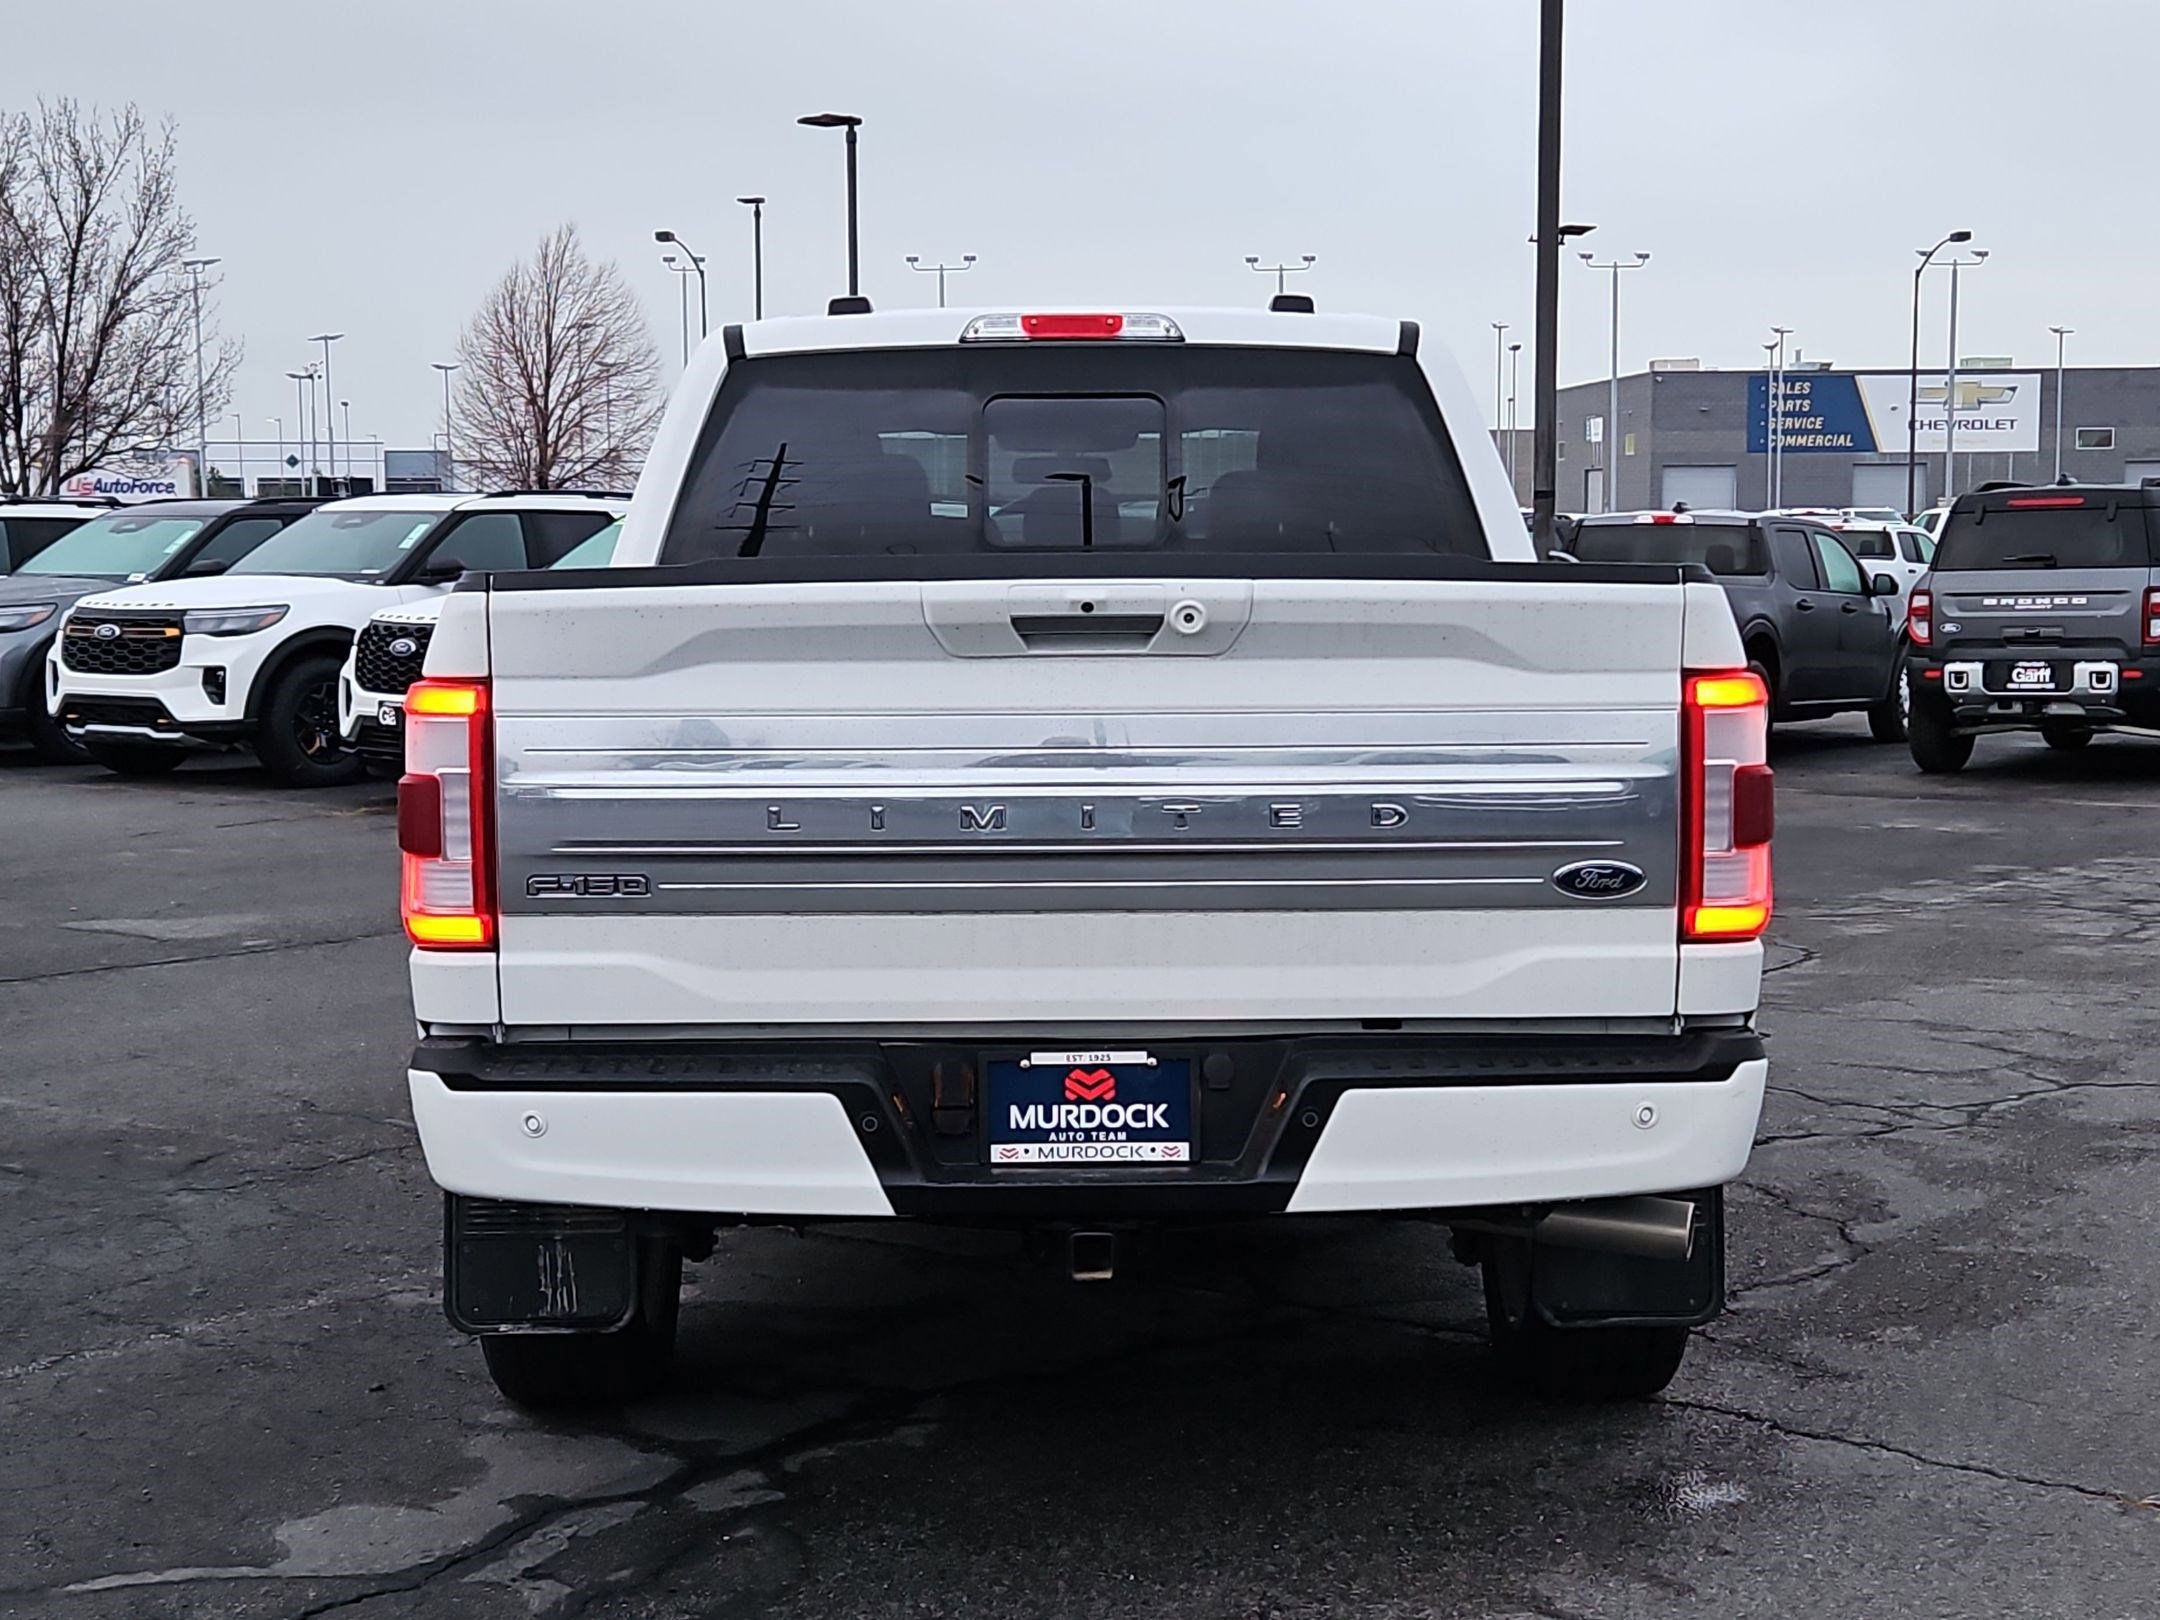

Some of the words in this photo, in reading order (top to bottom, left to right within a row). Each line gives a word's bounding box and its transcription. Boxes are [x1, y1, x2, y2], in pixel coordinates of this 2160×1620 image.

[1768, 382, 1811, 395] SALES
[1768, 400, 1811, 412] PARTS
[1768, 417, 1824, 430] SERVICE
[1768, 434, 1854, 447] COMMERCIAL
[767, 803, 1409, 832] LIMITED
[1574, 868, 1625, 888] Ford
[526, 873, 651, 898] F-150
[1088, 1054, 1112, 1062] 1925
[1009, 1103, 1169, 1129] MURDOCK
[1048, 1131, 1085, 1142] AUTO
[1092, 1131, 1127, 1141] TEAM
[1037, 1145, 1144, 1160] MURDOCK
